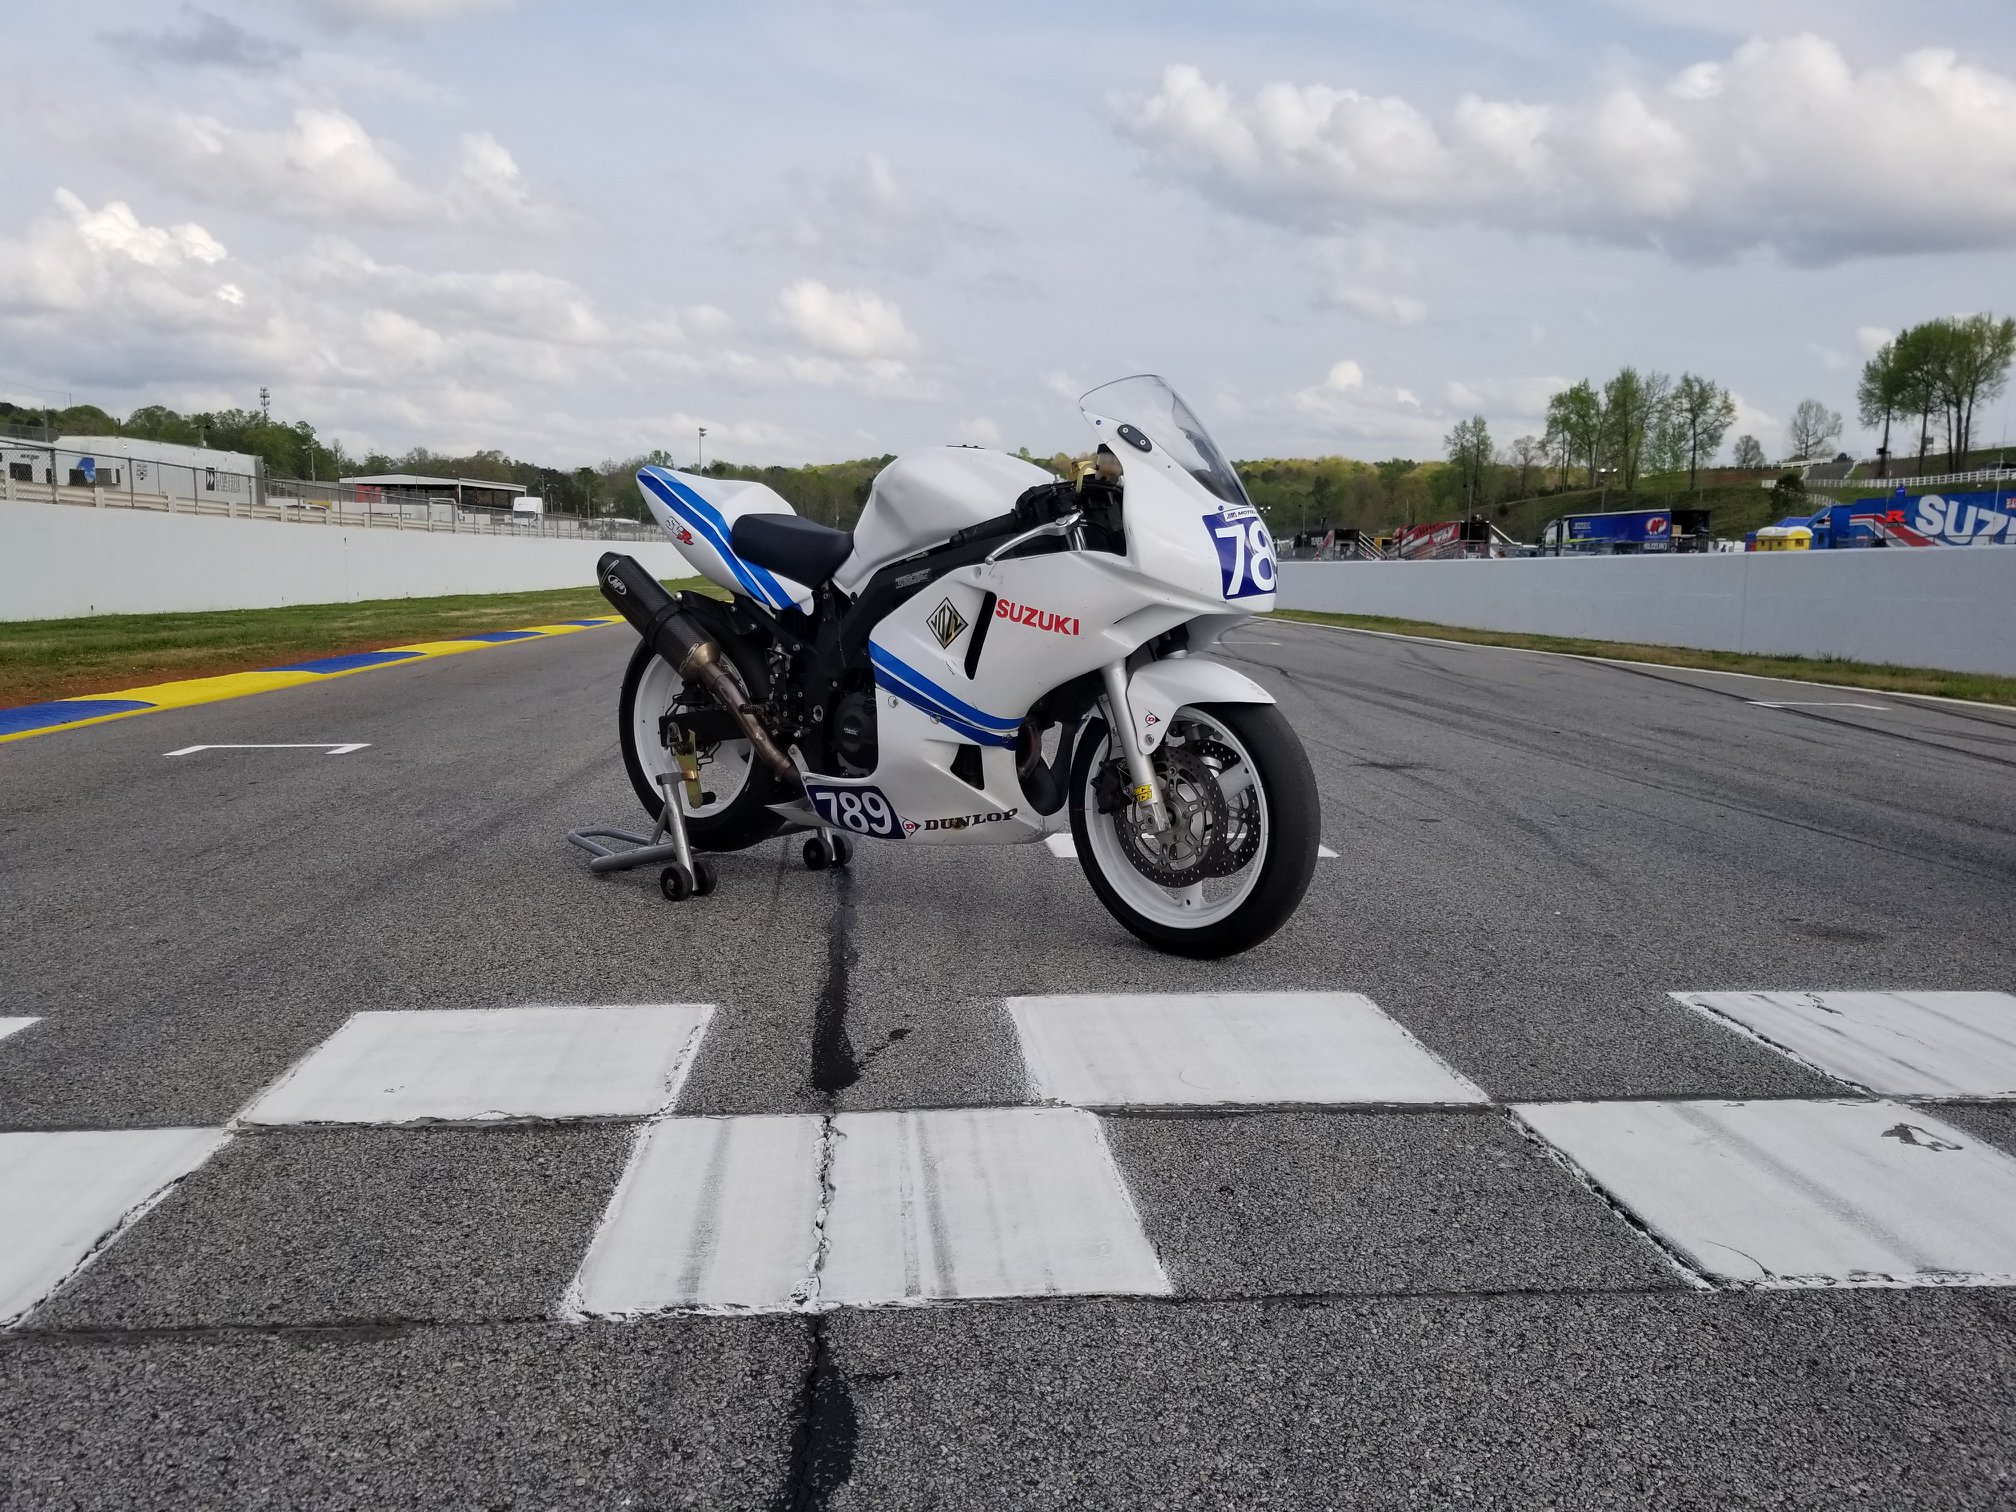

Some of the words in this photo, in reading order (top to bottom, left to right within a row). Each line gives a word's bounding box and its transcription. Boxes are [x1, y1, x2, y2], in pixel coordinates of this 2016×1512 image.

[1238, 509, 1255, 517] MOTO
[1215, 520, 1276, 595] 78
[996, 599, 1079, 635] SUZUKI
[816, 792, 892, 835] 789
[924, 808, 1018, 831] DUNLOP
